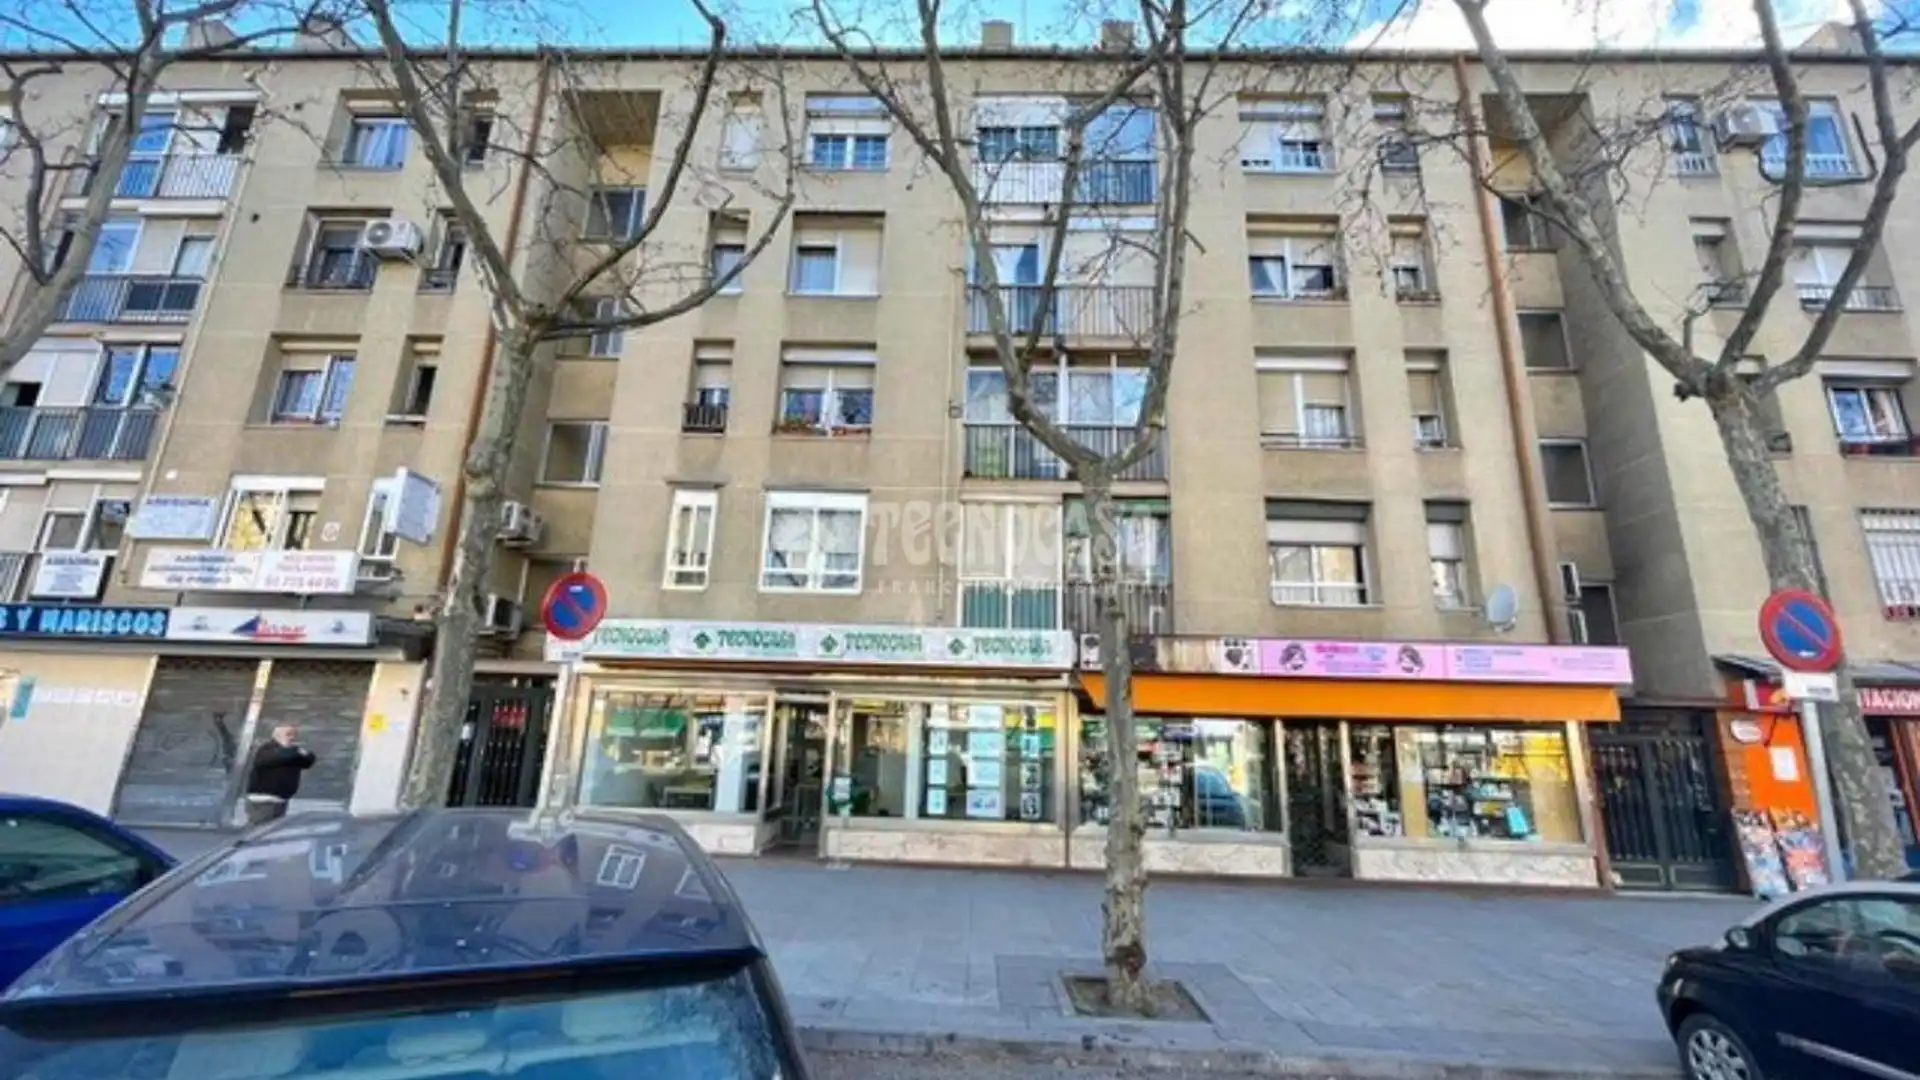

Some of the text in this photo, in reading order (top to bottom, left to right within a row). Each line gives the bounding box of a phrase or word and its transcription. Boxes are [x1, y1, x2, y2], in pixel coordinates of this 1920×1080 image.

[17, 606, 33, 631] Y
[39, 608, 166, 636] MARISCOS
[716, 629, 796, 649] TECNOCASA
[843, 632, 923, 652] TECNOCASA
[972, 635, 1053, 657] TECNOCASA
